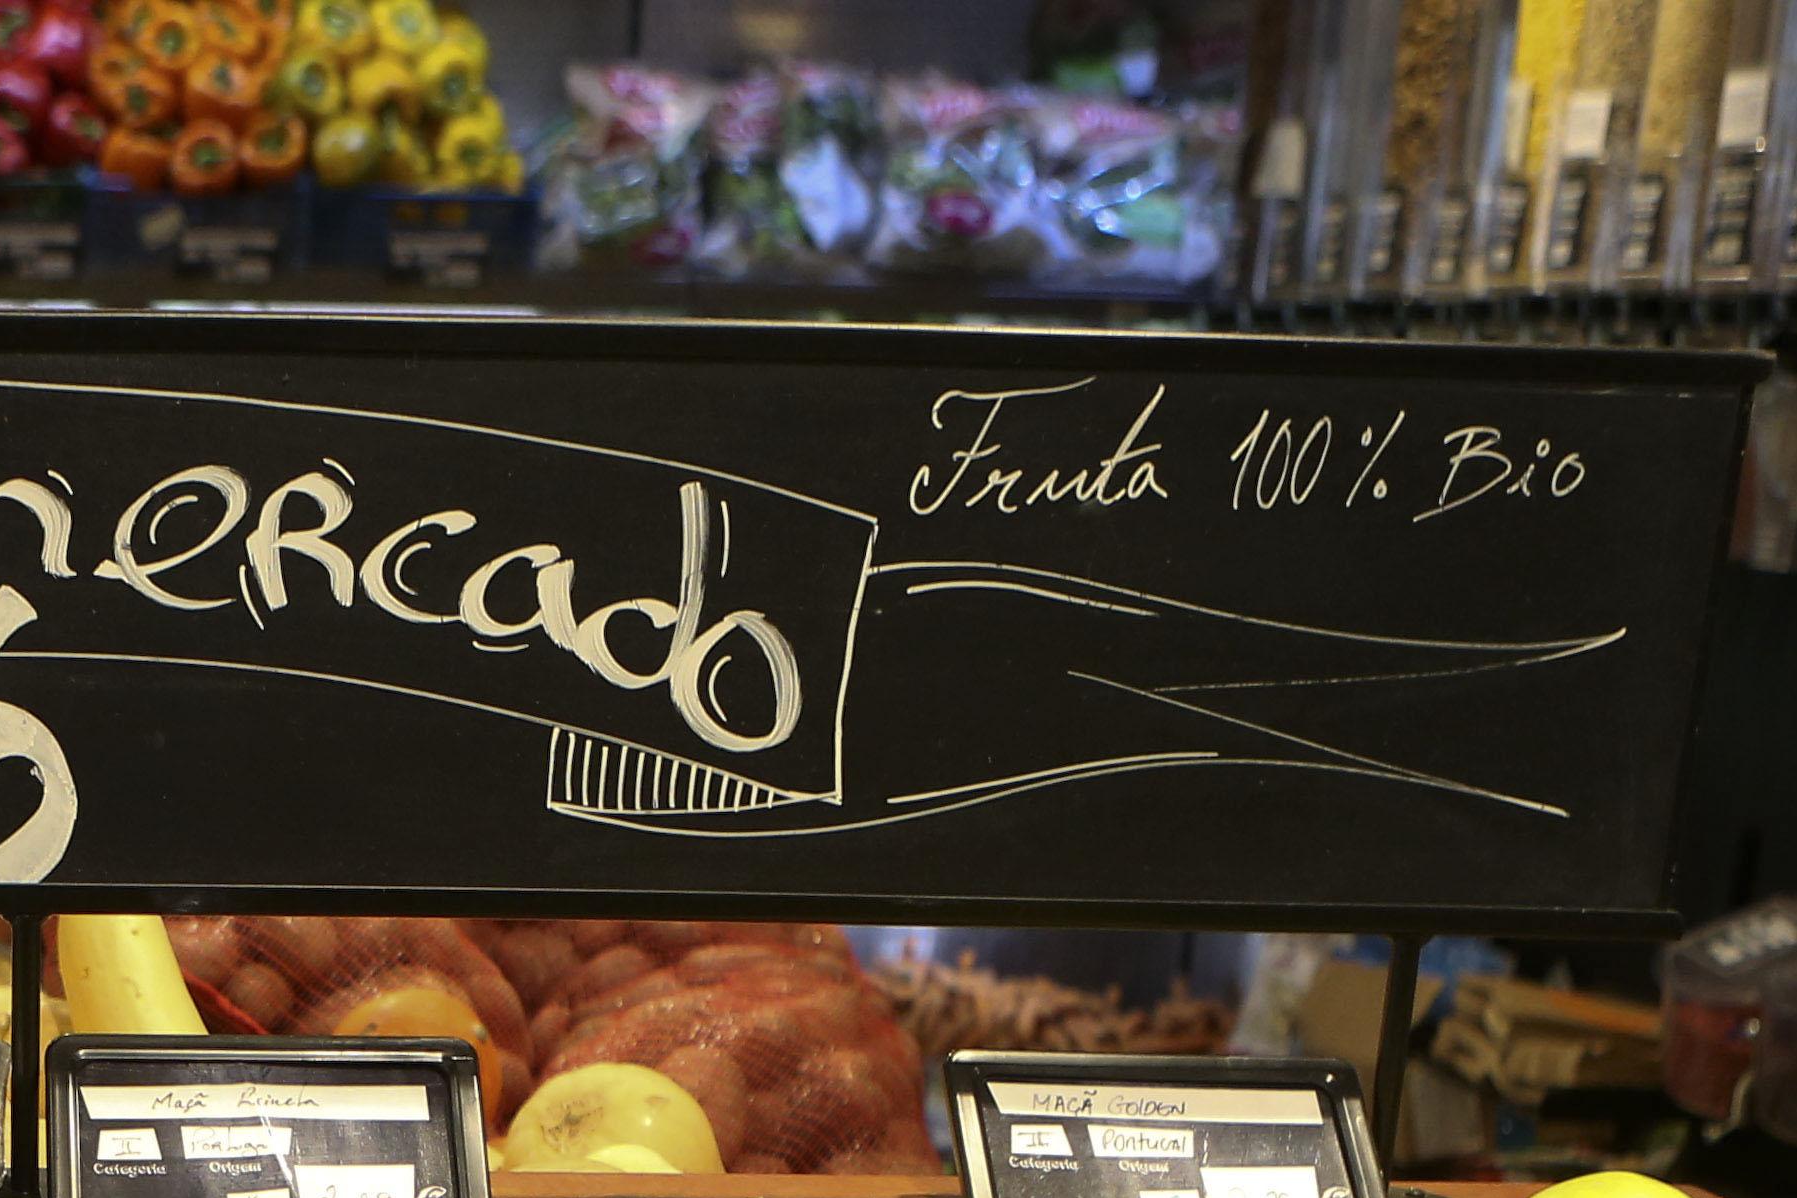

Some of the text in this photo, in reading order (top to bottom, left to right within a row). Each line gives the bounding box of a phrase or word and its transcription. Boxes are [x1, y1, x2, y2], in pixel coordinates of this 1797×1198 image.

[908, 377, 1168, 515] Fruta
[1412, 425, 1586, 522] Bio
[152, 1092, 209, 1113] Maçã
[1032, 1090, 1097, 1117] MAÇÃ
